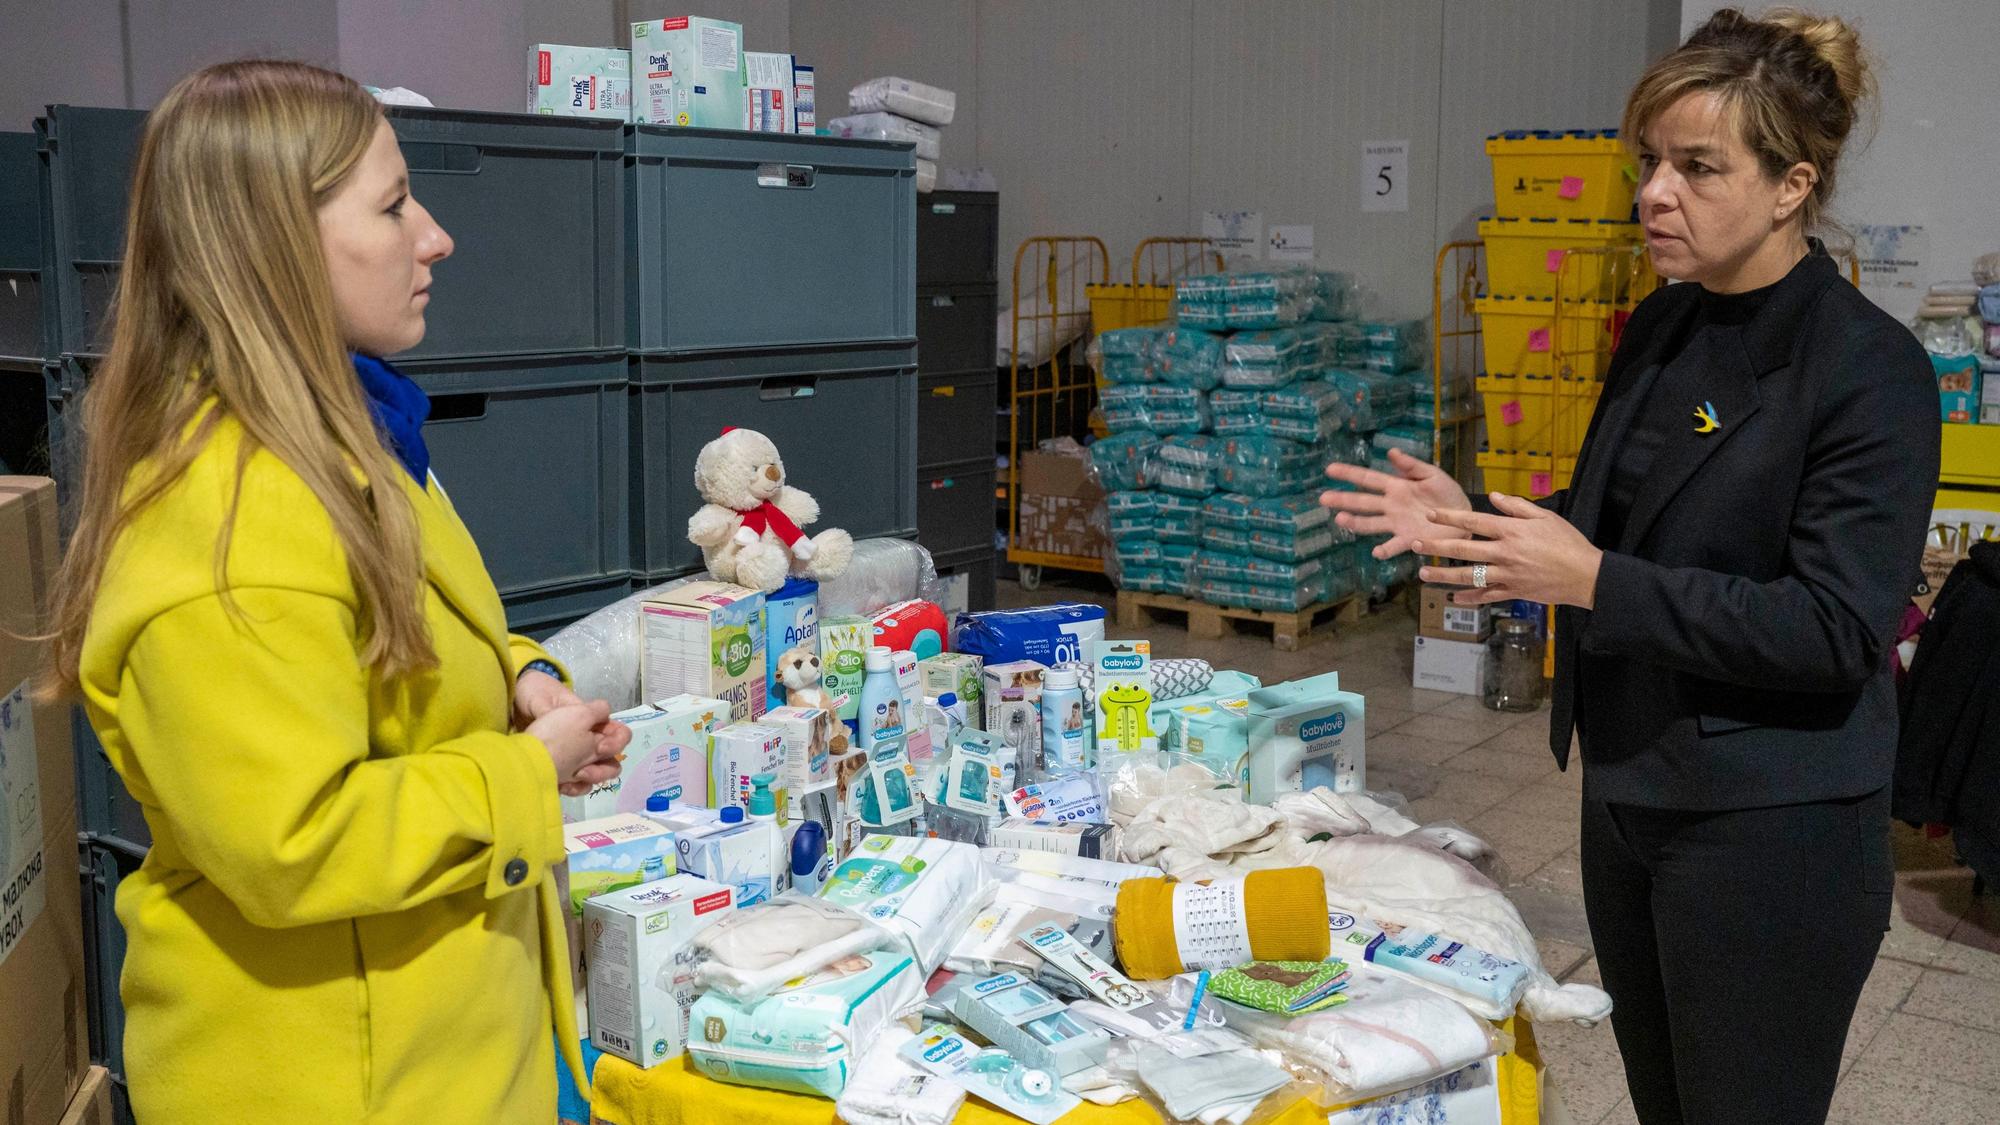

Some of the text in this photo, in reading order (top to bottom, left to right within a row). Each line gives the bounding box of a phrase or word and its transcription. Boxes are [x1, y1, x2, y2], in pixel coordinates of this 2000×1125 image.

[649, 54, 668, 65] Denk
[657, 63, 669, 72] mit
[572, 80, 583, 107] Denk
[582, 80, 590, 95] mit
[649, 88, 671, 96] SENSITIVE
[1376, 166, 1392, 196] 5
[731, 642, 750, 662] Bio
[841, 655, 861, 667] Bio
[899, 662, 916, 675] HiPP
[1104, 658, 1141, 668] babylove
[875, 727, 902, 739] babylove
[1302, 720, 1343, 738] babylove
[763, 736, 782, 753] HiPP
[768, 754, 777, 763] Bio
[740, 775, 750, 806] HiPP
[580, 832, 608, 846] PRE
[2, 851, 42, 915] малюка
[839, 864, 886, 898] Pampers
[977, 975, 1018, 992] babylove
[707, 1020, 715, 1038] OPEN
[925, 1038, 963, 1062] babylove
